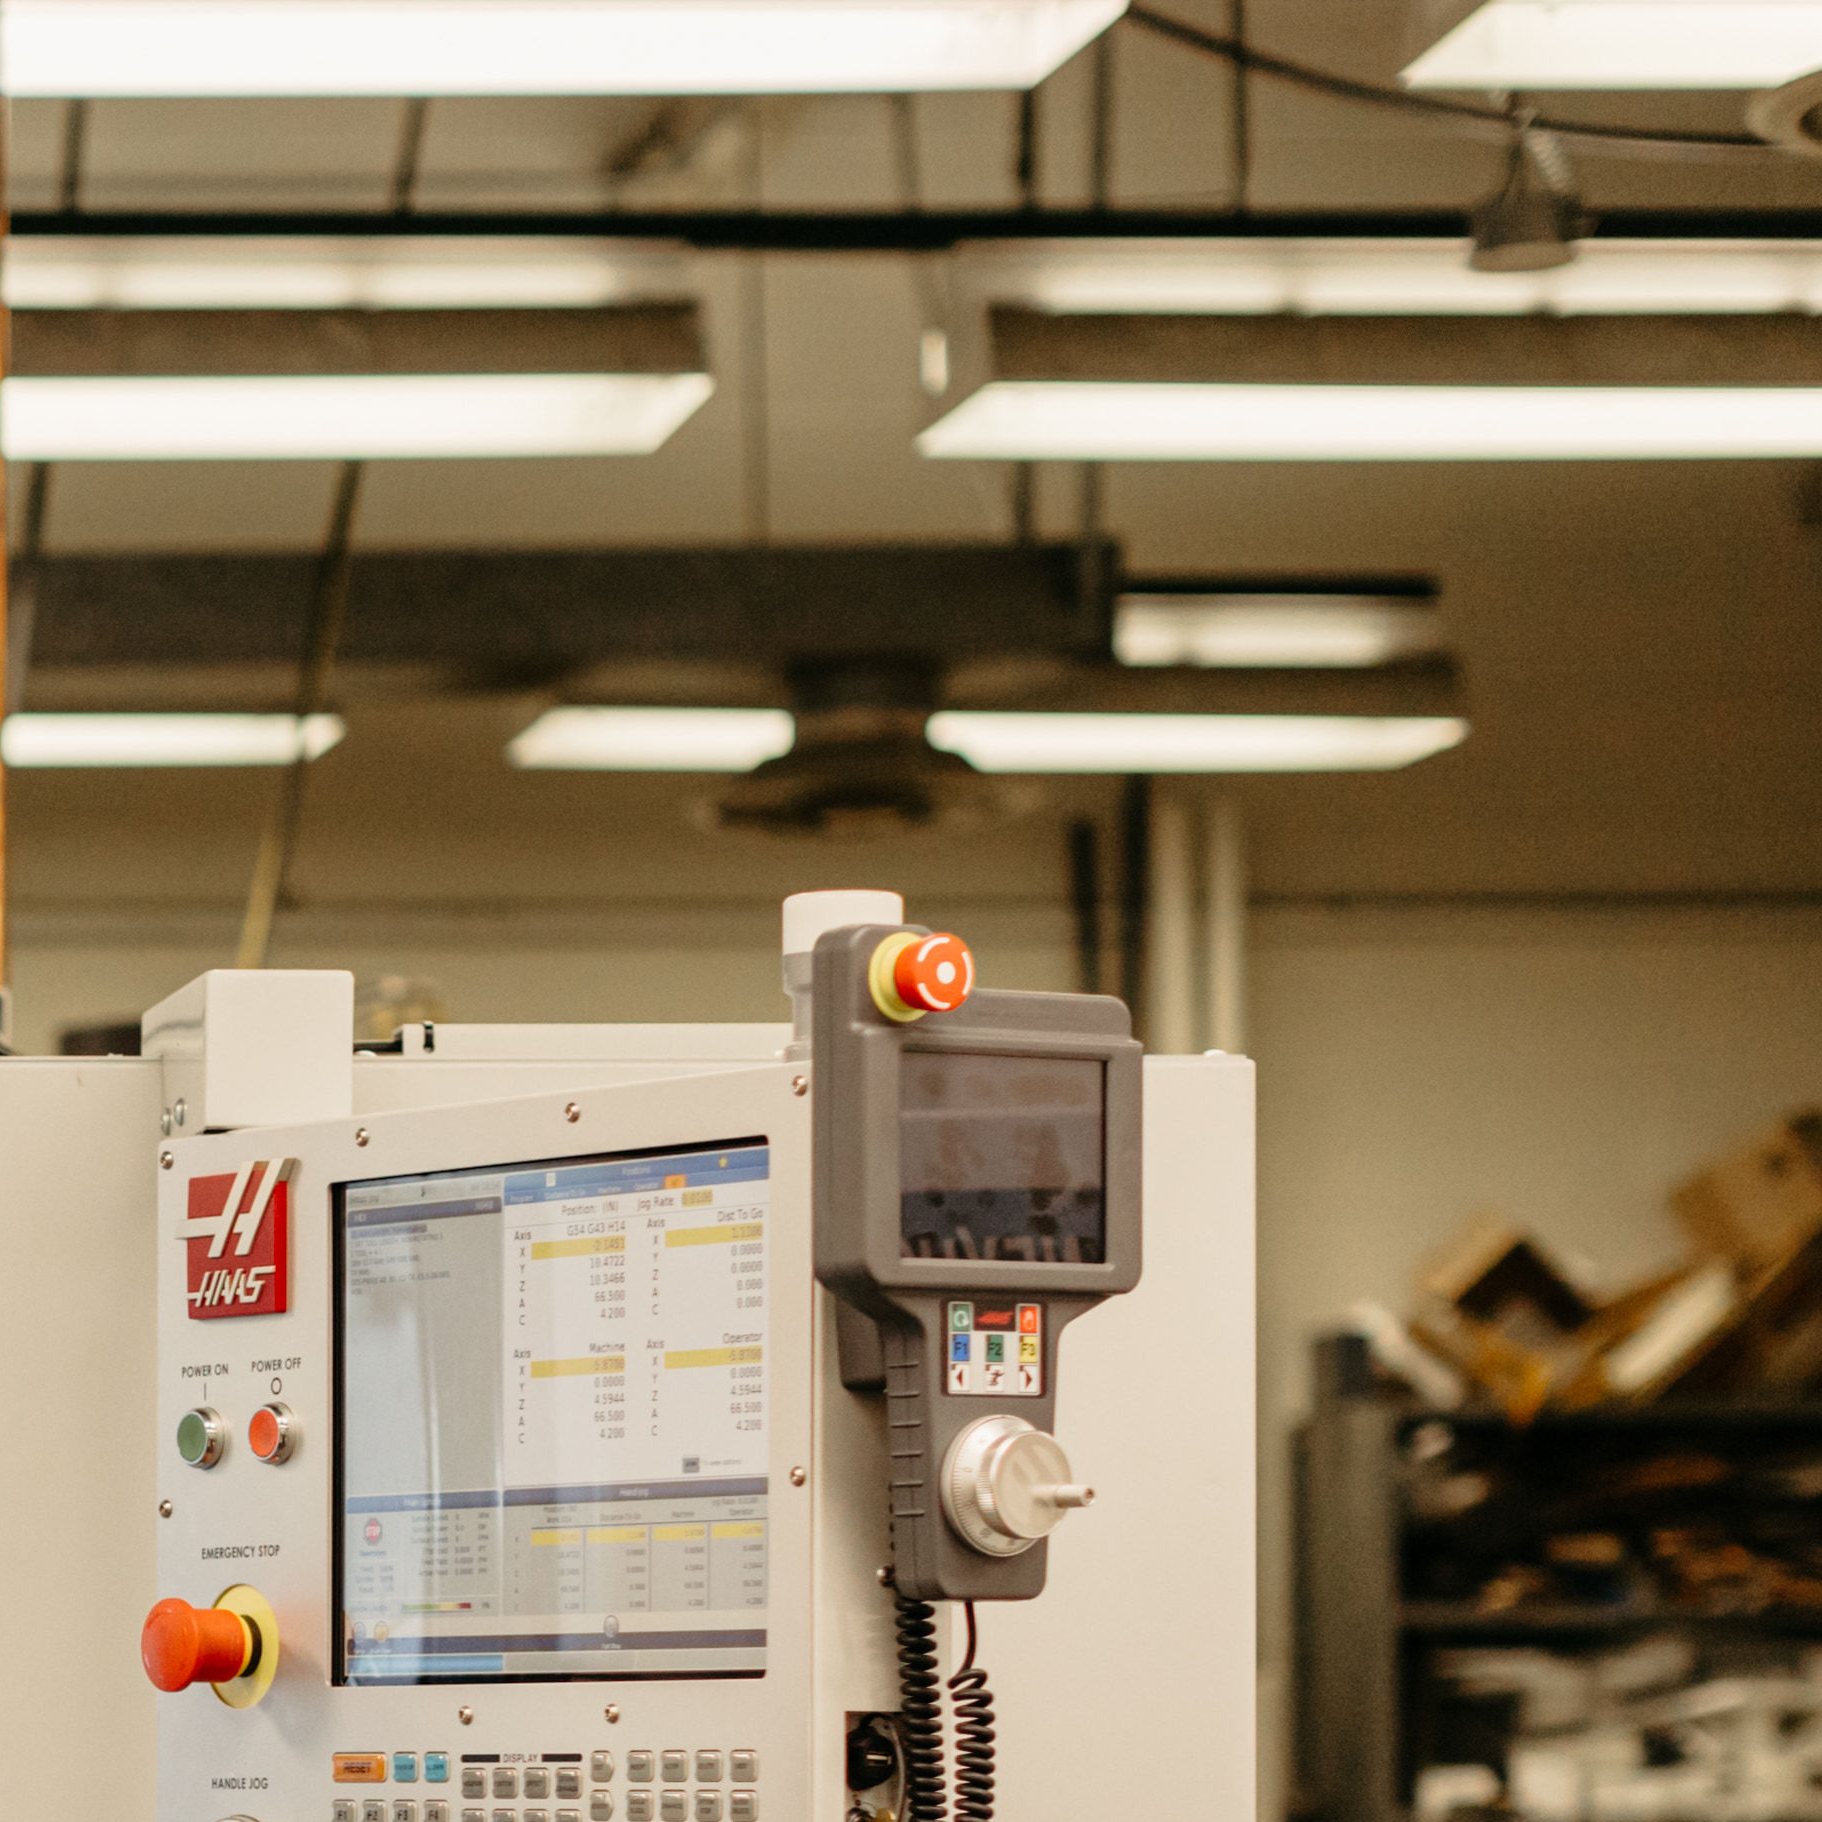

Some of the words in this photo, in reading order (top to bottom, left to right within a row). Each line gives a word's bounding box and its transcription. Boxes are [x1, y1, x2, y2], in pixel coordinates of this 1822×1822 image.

[646, 1218, 666, 1229] Axis
[514, 1230, 532, 1241] Axis
[519, 1247, 526, 1258] X
[186, 1266, 276, 1308] HAAS
[646, 1339, 665, 1349] Axis
[722, 1332, 763, 1345] Operator
[514, 1348, 531, 1359] Axis
[589, 1342, 625, 1354] Machine
[954, 1341, 967, 1356] F1
[988, 1342, 1002, 1356] F2
[1021, 1343, 1036, 1356] F3
[182, 1366, 211, 1379] POWER
[214, 1363, 229, 1376] ON
[251, 1358, 282, 1373] POWER
[284, 1357, 302, 1370] OFF
[201, 1546, 255, 1560] EMERGENCY
[258, 1545, 280, 1557] STOP
[503, 1753, 538, 1763] DISPLAY
[212, 1777, 246, 1790] HANDLE
[249, 1778, 269, 1790] JOG
[338, 1810, 347, 1821] F1
[367, 1810, 378, 1821] F2
[397, 1809, 408, 1821] F3
